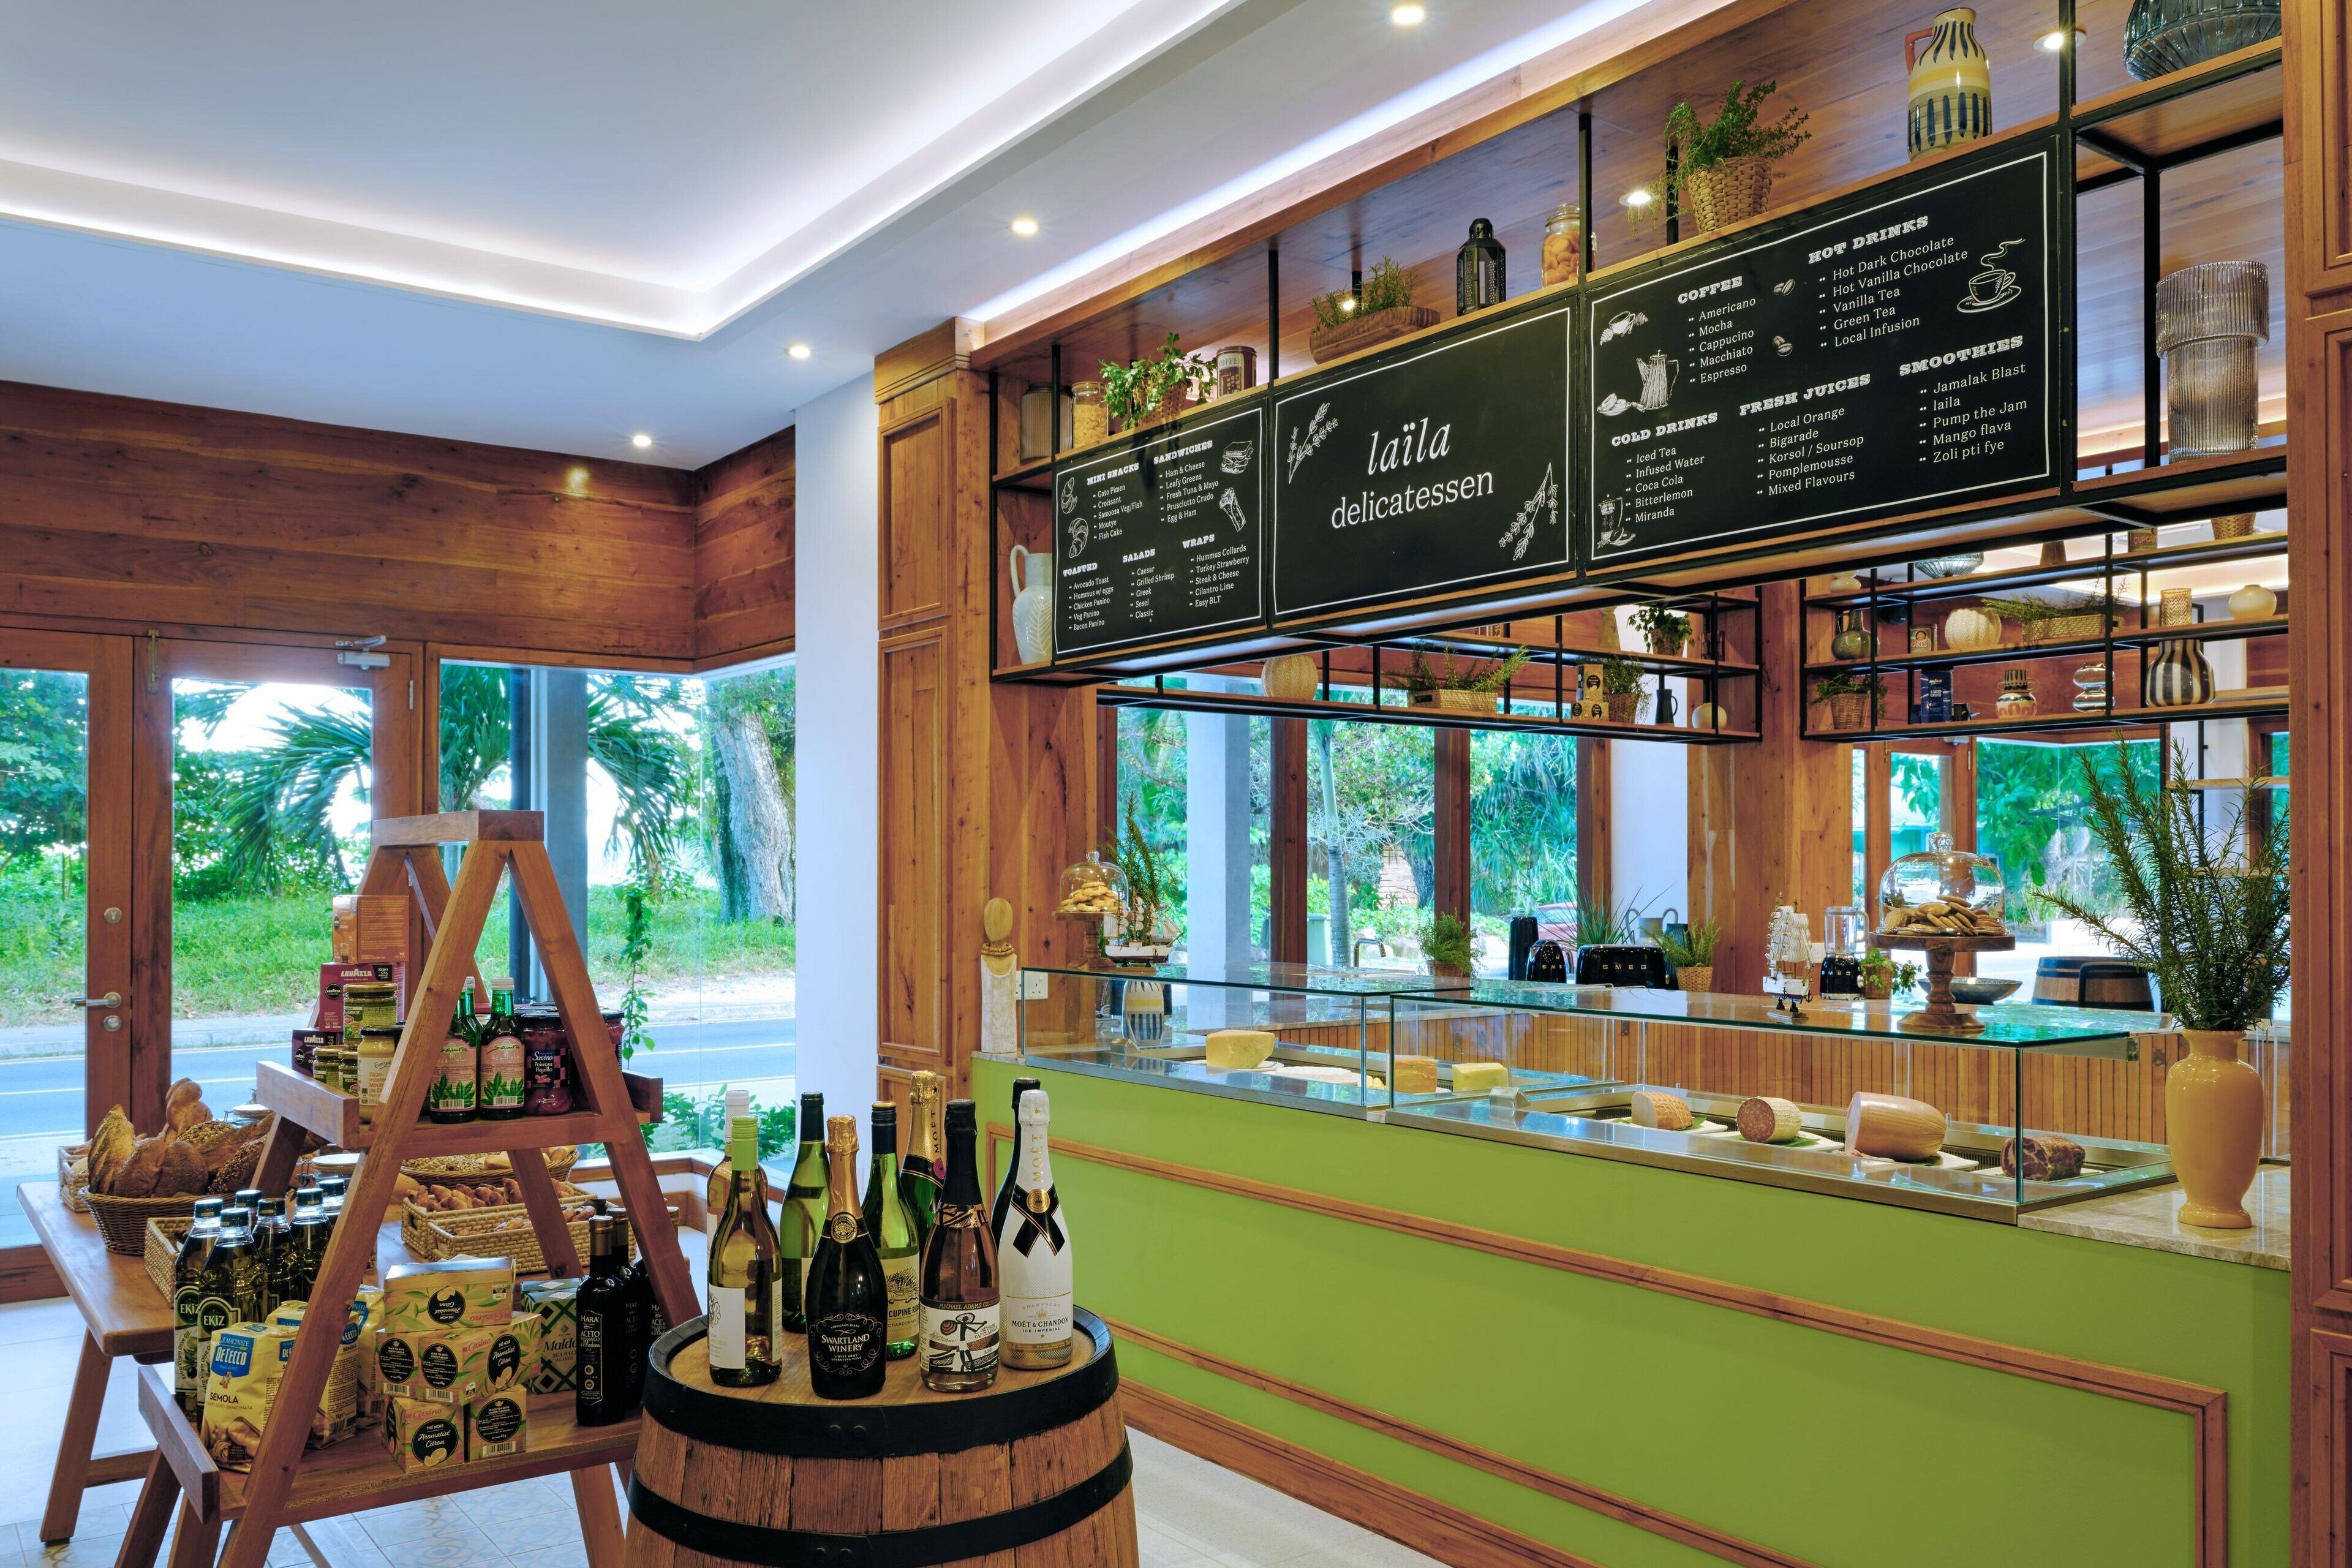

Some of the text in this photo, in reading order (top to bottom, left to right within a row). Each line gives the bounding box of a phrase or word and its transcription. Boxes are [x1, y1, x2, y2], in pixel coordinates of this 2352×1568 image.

[1808, 215, 1928, 264] HOT DRINKS
[1833, 237, 1954, 281] Hot Dark Chocolate
[1833, 251, 1968, 297] Hot Vanilla Chocolate
[1678, 276, 1743, 304] COFFEE
[1833, 288, 1901, 313] Vanilla Tea
[1698, 298, 1756, 322] Americano
[1834, 307, 1896, 330] Green Tea
[1699, 320, 1733, 337] Mocha
[1834, 317, 1920, 347] Local Infusion
[1699, 330, 1754, 352] Cappucino
[1700, 346, 1753, 368] Macchiato
[1899, 335, 2023, 377] SMOOTHIES
[1700, 364, 1747, 383] Espresso
[1933, 363, 2026, 394] Jamalak Blast
[1739, 373, 1871, 416] FRESH JUICES
[1934, 396, 1961, 411] laila
[1770, 408, 1845, 432] Local Orange
[1933, 400, 2027, 428] Pump the Jam
[1611, 412, 1718, 447] COLD DRINKS
[1770, 428, 1819, 448] Bigarade
[1933, 422, 2011, 446] Mango flava
[1153, 440, 1213, 465] SANDWICHES
[1368, 417, 1450, 475] laïla
[1769, 436, 1864, 464] Korsol / Soursop
[1933, 440, 2005, 463] Zoli pti fye
[1637, 447, 1676, 464] Iced Tea
[1087, 462, 1139, 486] MINI SNACKS
[1165, 469, 1178, 478] Ham
[1184, 461, 1205, 472] Cheese
[1636, 456, 1705, 478] Infused Water
[1768, 455, 1853, 480] Pomplemousse
[1166, 473, 1202, 489] Leafy Greens
[1635, 474, 1684, 493] Coca Cola
[1768, 471, 1855, 496] Mixed Flavours
[1097, 484, 1126, 498] Gato Pimen
[1166, 480, 1219, 500] Fresh Tuna & Mayo
[1635, 489, 1693, 508] Bitterlemon
[1098, 496, 1121, 508] Croissant
[1167, 492, 1214, 511] Prusciutto Crudo
[1332, 472, 1493, 528] delicatessen
[1098, 500, 1143, 519] Samoosa Veg/Fish
[1167, 509, 1197, 524] Egg & Ham
[1635, 507, 1675, 523] Miranda
[1099, 528, 1123, 540] Fish Cake
[1182, 533, 1215, 549] WRAPS
[1123, 548, 1156, 563] SALADS
[1196, 544, 1246, 562] Hummus Collards
[1063, 562, 1098, 577] TOASTED
[1137, 567, 1155, 576] Caesar
[1196, 556, 1250, 573] Turkey Strawberry
[1073, 576, 1109, 590] Avocado Toast
[1136, 573, 1175, 587] Grilled Shrimp
[1195, 574, 1212, 585] Steak
[1218, 570, 1240, 580] Cheese
[1074, 590, 1095, 600] Hummus
[1102, 586, 1114, 595] eggs
[1136, 587, 1152, 597] Greek
[1195, 582, 1234, 596] Cilantro Lime
[1073, 598, 1110, 611] Chicken Panino
[1135, 598, 1149, 608] Sesel
[1195, 595, 1221, 608] Easy BLT
[1073, 610, 1099, 622] Veg Panino
[1135, 609, 1154, 619] Classic
[1088, 619, 1105, 628] Panino
[341, 968, 372, 977] LAVAZZA
[532, 1051, 553, 1061] Savino
[1038, 1316, 1069, 1328] CHANDON
[468, 1339, 491, 1352] Casino
[828, 1343, 864, 1352] WINERY
[209, 1392, 239, 1404] SEMOLA
[413, 1409, 442, 1418] Casino
